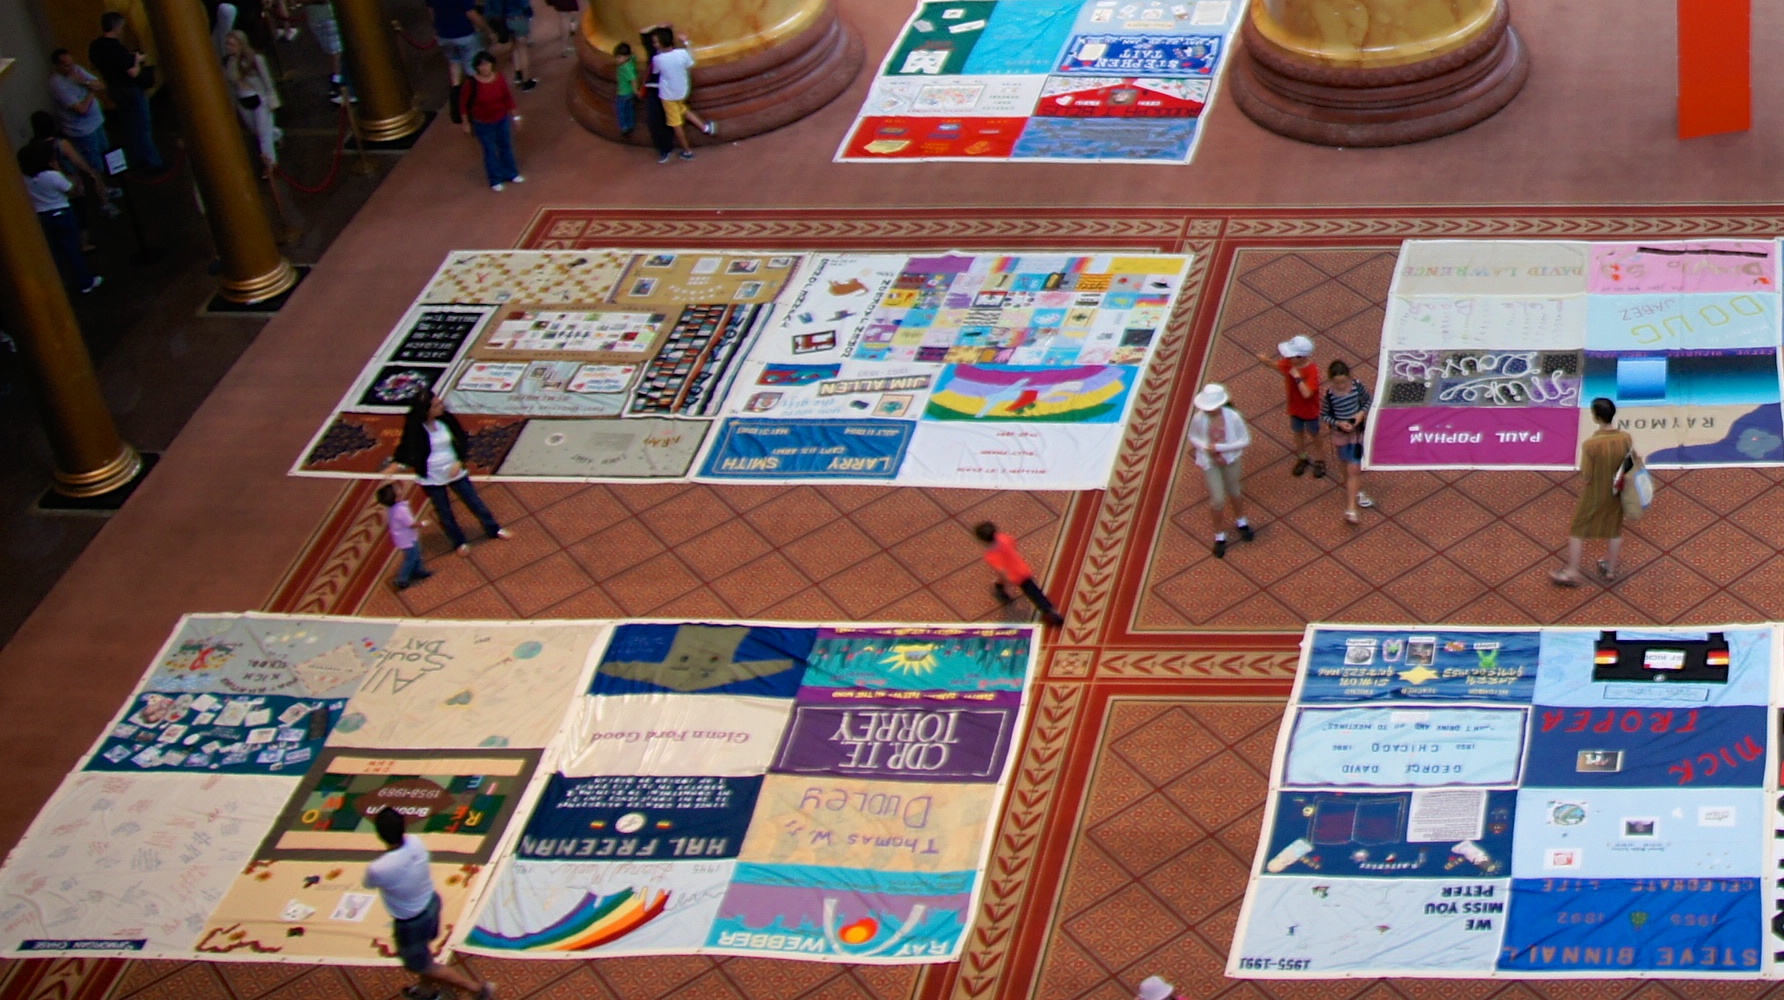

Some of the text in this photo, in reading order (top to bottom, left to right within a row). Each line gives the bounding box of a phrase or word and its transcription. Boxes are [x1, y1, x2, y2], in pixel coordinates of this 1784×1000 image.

[1118, 48, 1163, 58] TAIT
[1095, 58, 1180, 69] STEPHEN
[1403, 264, 1585, 278] DAVID LAWRENCE
[1617, 298, 1678, 321] JABEZ
[1631, 295, 1765, 344] DOUG
[1393, 350, 1541, 388] Davis
[820, 377, 925, 396] JIM ALLEN
[1439, 369, 1578, 406] Mike
[1409, 431, 1542, 444] PAUL POPHAM
[720, 456, 891, 470] LARRY SMITH
[359, 667, 428, 696] All
[1337, 675, 1519, 689] LARRY SIMON
[827, 711, 960, 744] TORREY
[1376, 724, 1389, 732] TO
[1413, 721, 1432, 732] AND
[1436, 723, 1462, 733] DRINK
[1539, 708, 1699, 734] TROPEA
[590, 730, 751, 745] Glenn Ford Good
[837, 740, 949, 771] CDR. T.E.
[1370, 742, 1441, 755] CHICAGO
[1666, 734, 1765, 785] NICK
[1340, 763, 1463, 776] GEORGE DAVID
[376, 786, 441, 800] 1958-1989
[517, 835, 727, 857] HAL FREEMAN
[1439, 885, 1495, 899] PETER
[1542, 878, 1756, 893] CELEBRATE LIFE
[1423, 902, 1504, 916] MISS YOU
[1464, 919, 1493, 932] WE
[716, 930, 950, 956] RAY WEBBER
[1655, 946, 1760, 966] STEVE
[1237, 957, 1312, 972] 1955-1991
